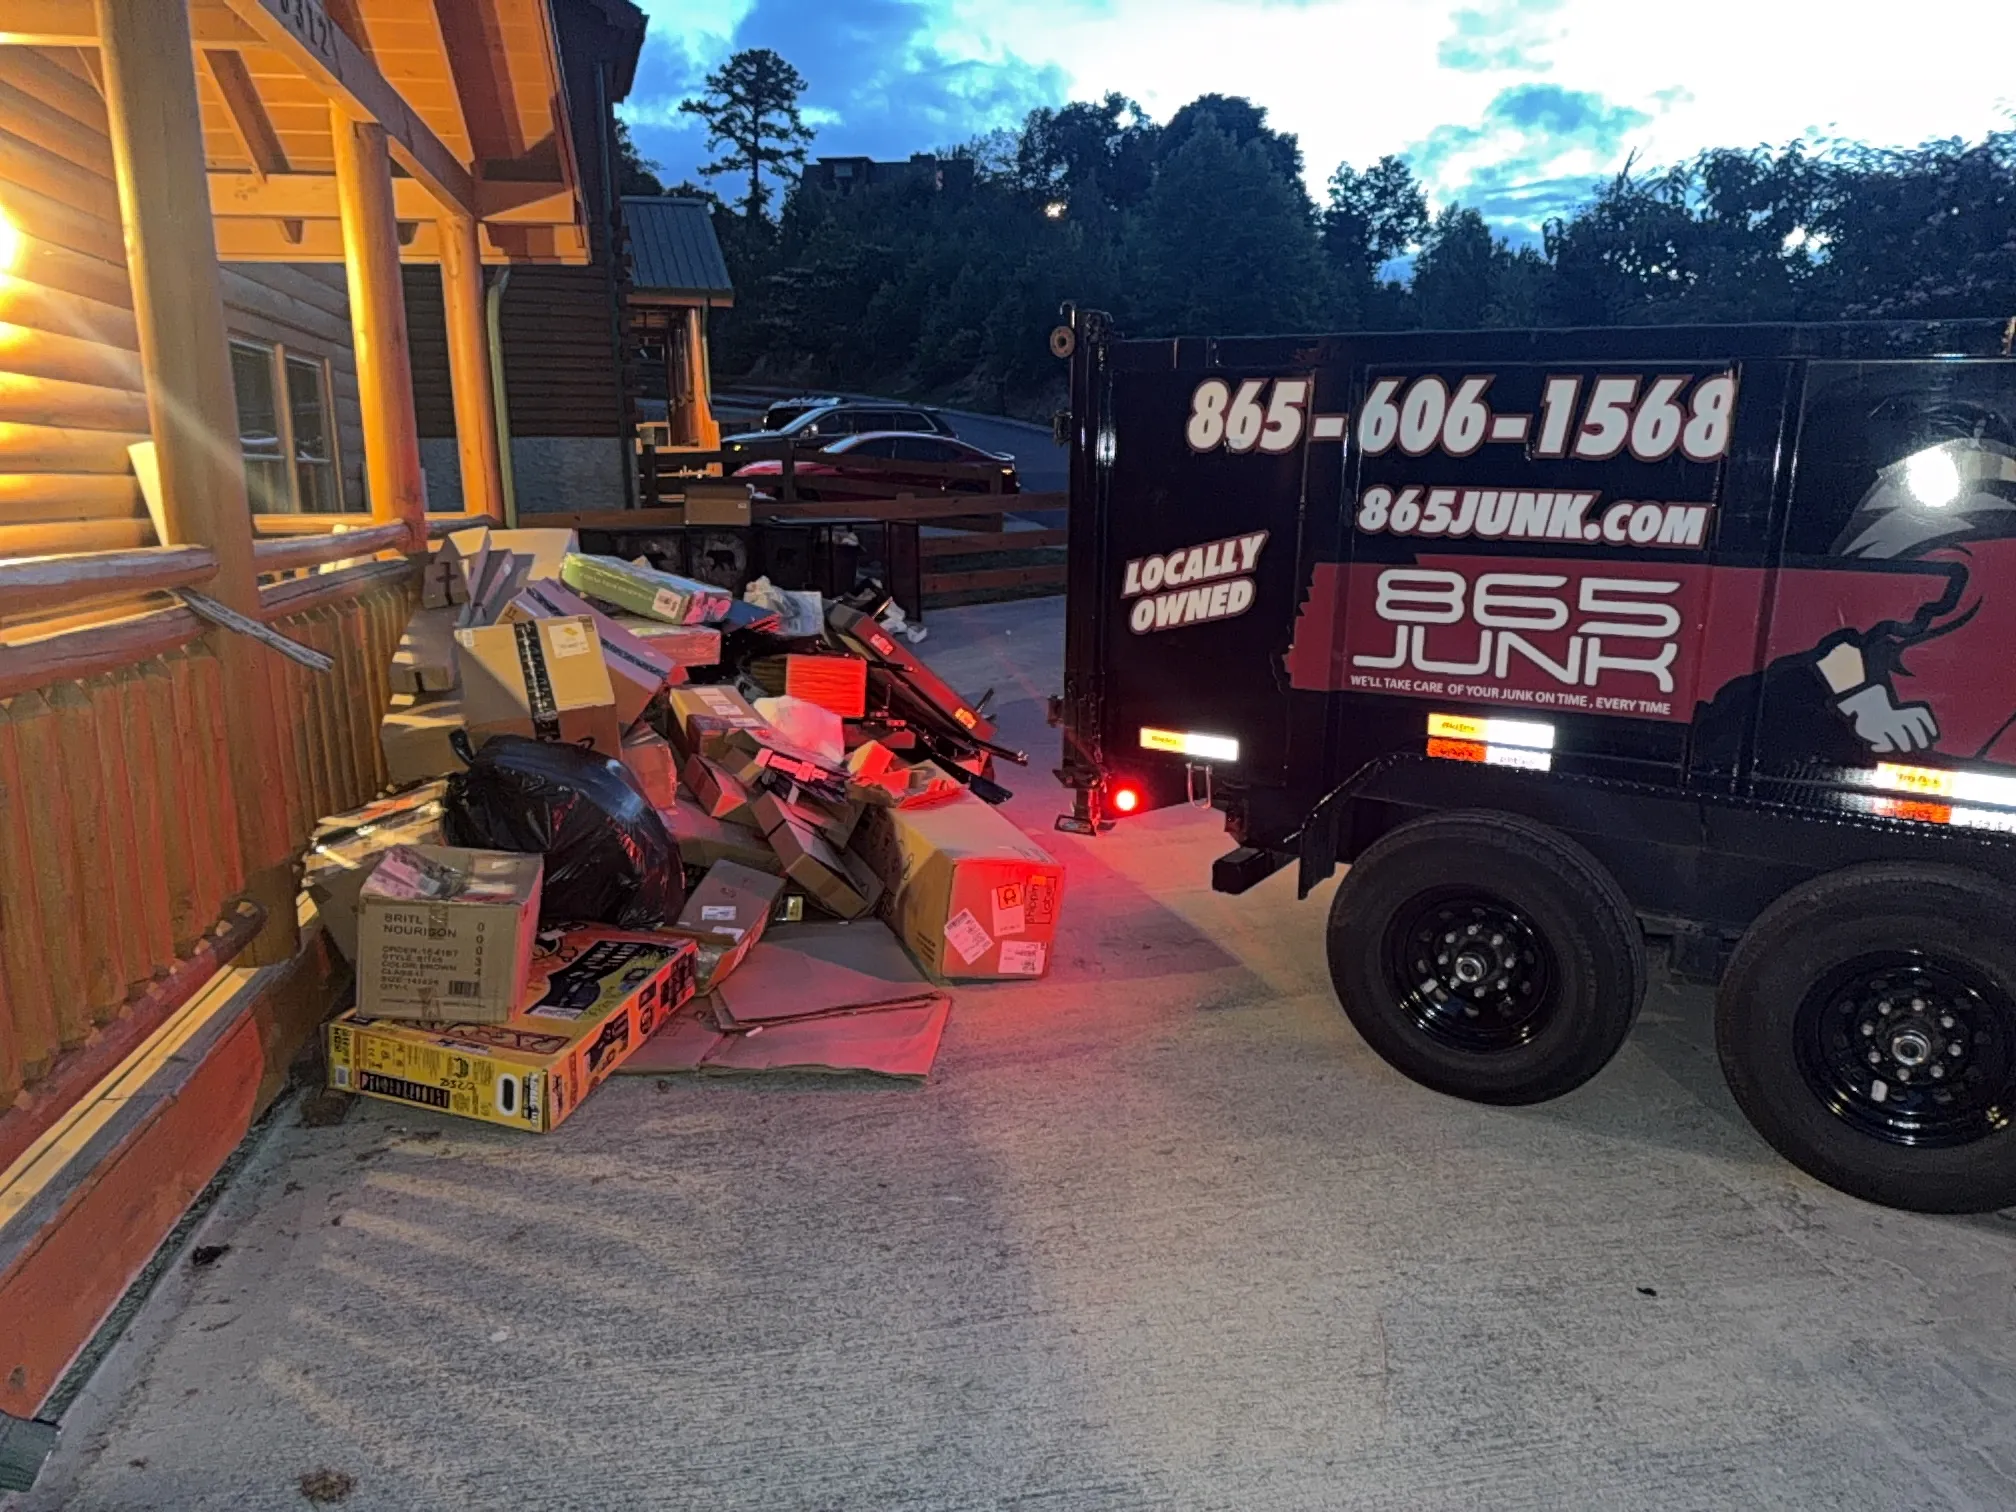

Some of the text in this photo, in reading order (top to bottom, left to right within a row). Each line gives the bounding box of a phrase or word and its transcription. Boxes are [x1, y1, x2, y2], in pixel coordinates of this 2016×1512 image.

[1186, 376, 1733, 458] 865-606-1568
[1122, 532, 1268, 596] LOCALLY
[1130, 579, 1254, 632] OWNED
[1375, 568, 1681, 638] 865
[1352, 624, 1679, 693] JUNK
[1350, 674, 1384, 688] WE'LL
[1384, 677, 1412, 690] TAKE
[1413, 679, 1444, 693] CARE
[1448, 683, 1464, 695] OF
[1465, 684, 1499, 698] YOUR
[1500, 687, 1534, 702] JUNK
[1536, 691, 1555, 704] ON
[1595, 696, 1639, 713] EVERY
[1638, 700, 1671, 715] TIME
[383, 912, 424, 925] BRITL
[383, 923, 457, 938] NOURISON
